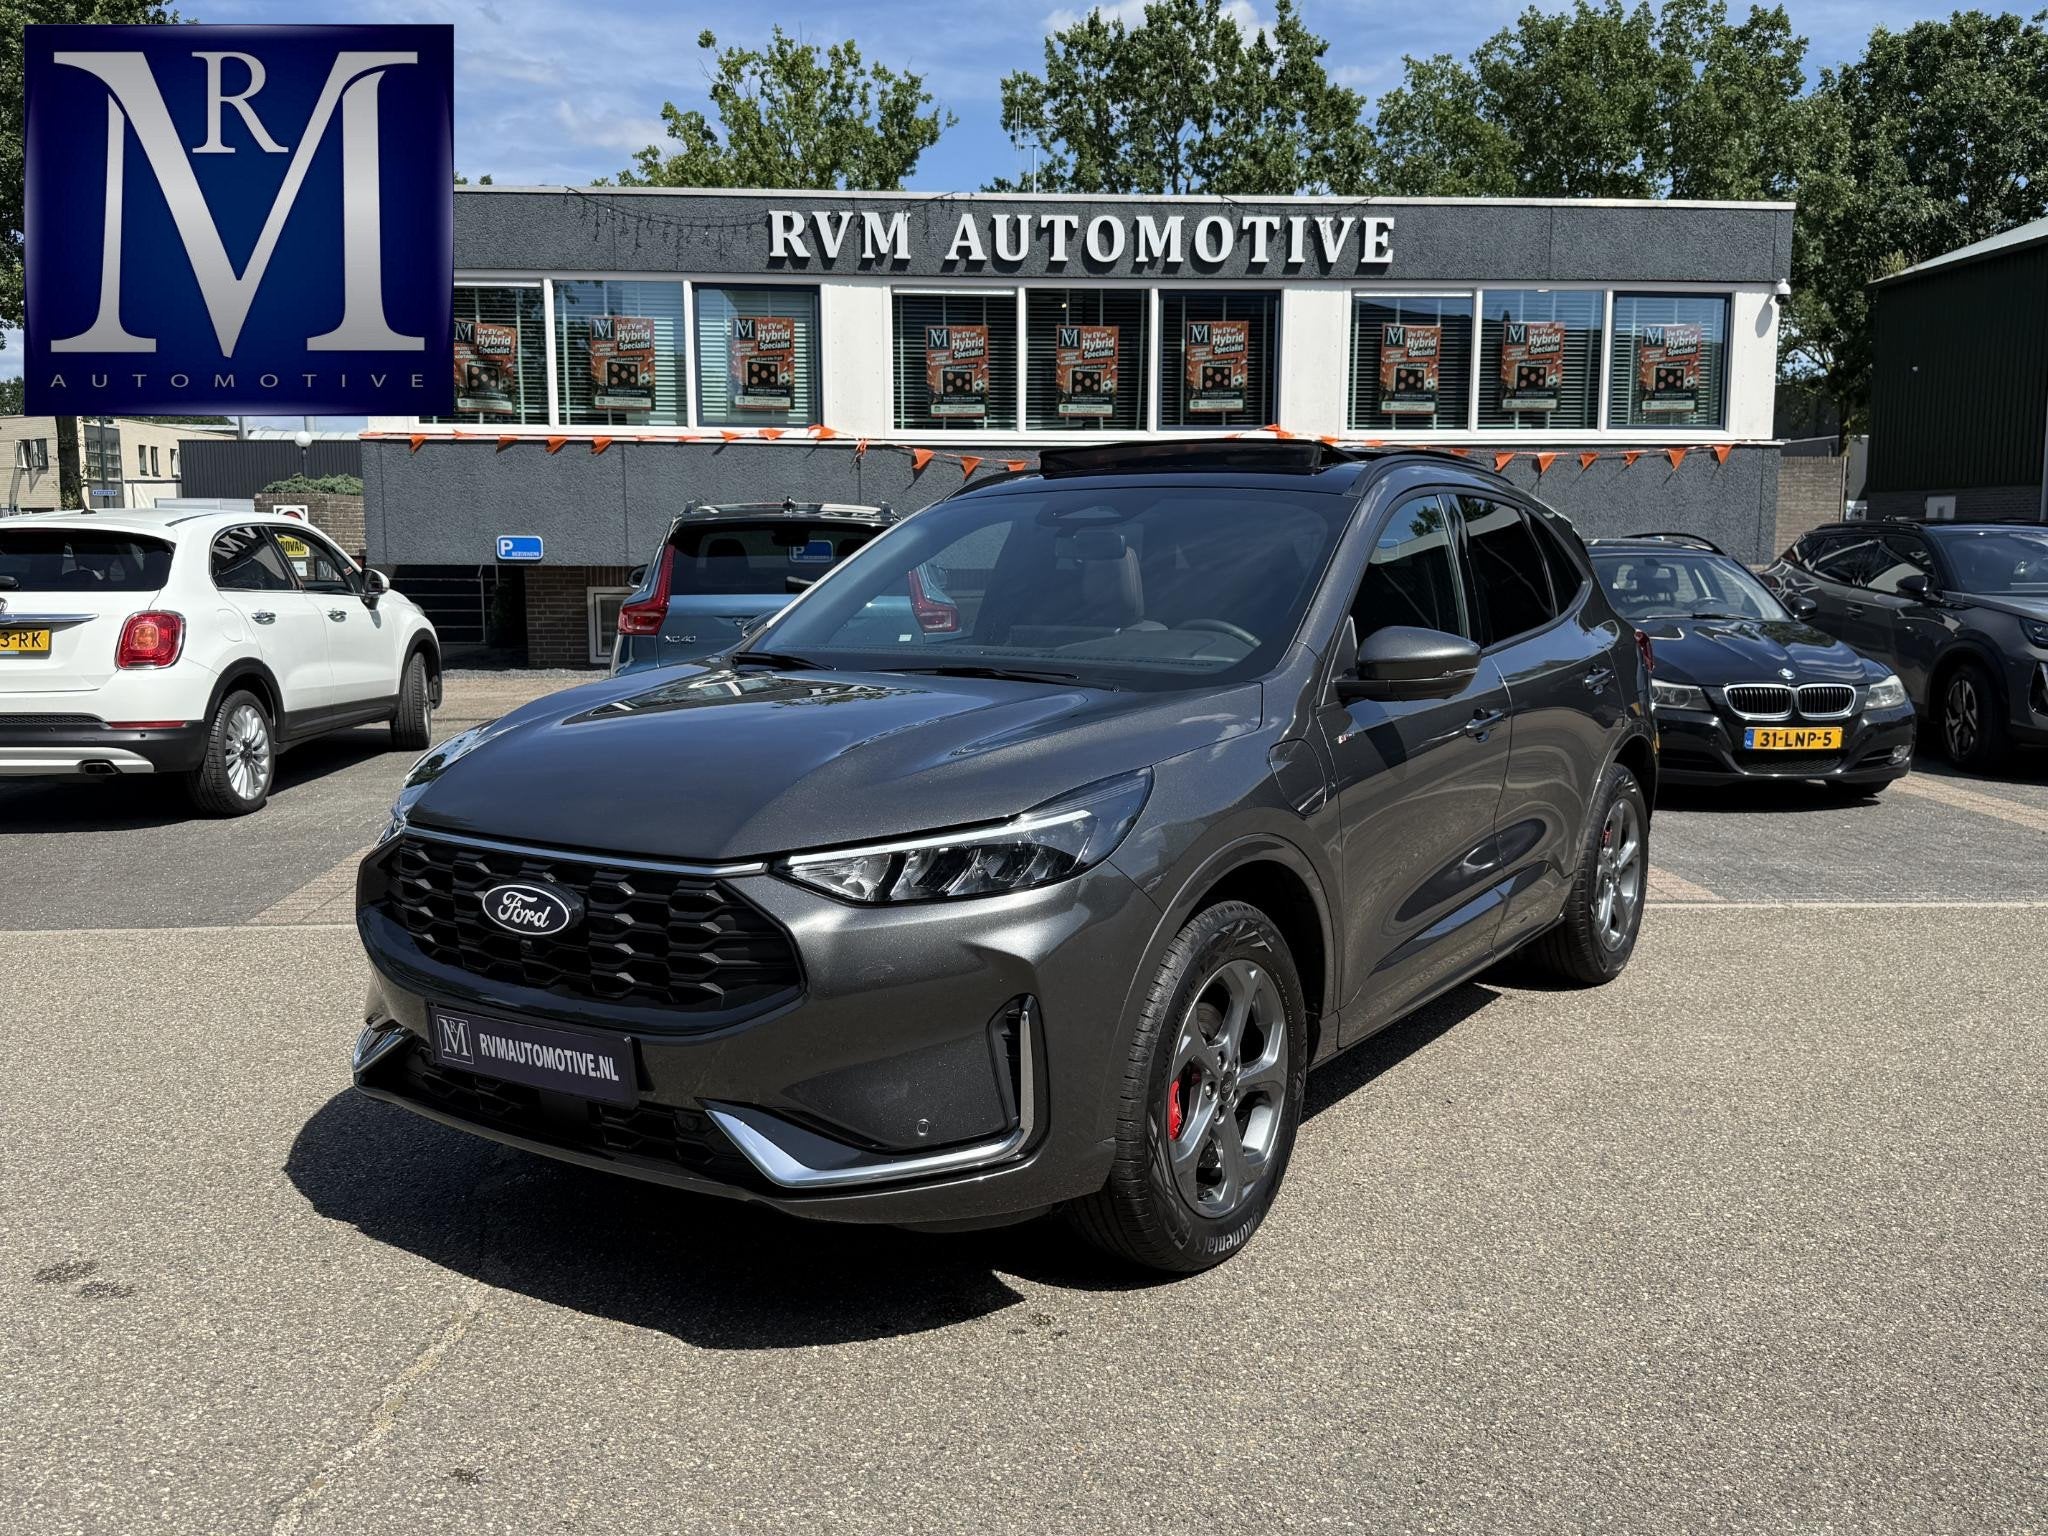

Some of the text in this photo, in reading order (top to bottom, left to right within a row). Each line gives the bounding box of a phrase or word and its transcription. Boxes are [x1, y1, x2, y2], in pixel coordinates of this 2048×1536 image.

[768, 210, 1395, 263] RVM AUTOMOTIVE
[477, 335, 511, 347] Hybrid
[617, 330, 650, 343] Hybrid
[758, 330, 790, 343] Hybrid
[1213, 333, 1244, 346] Hybrid
[1529, 333, 1560, 346] Hybrid
[1666, 335, 1697, 348] Hybrid
[619, 342, 649, 350] Specialist
[760, 342, 790, 350] Specialist
[952, 337, 984, 351] Hybrid
[1083, 337, 1114, 351] Hybrid
[1215, 344, 1243, 354] Specialist
[1407, 337, 1437, 350] Hybrid
[1530, 345, 1559, 354] Specialist
[954, 349, 984, 359] Specialist
[1084, 349, 1114, 359] Specialist
[1409, 349, 1435, 357] Specialist
[1668, 346, 1696, 356] Specialist
[500, 540, 513, 555] P
[1760, 732, 1832, 747] 31-LNP-5
[498, 891, 551, 928] Ford
[479, 1032, 620, 1081] RVMAUTOMOTIVE.NL
